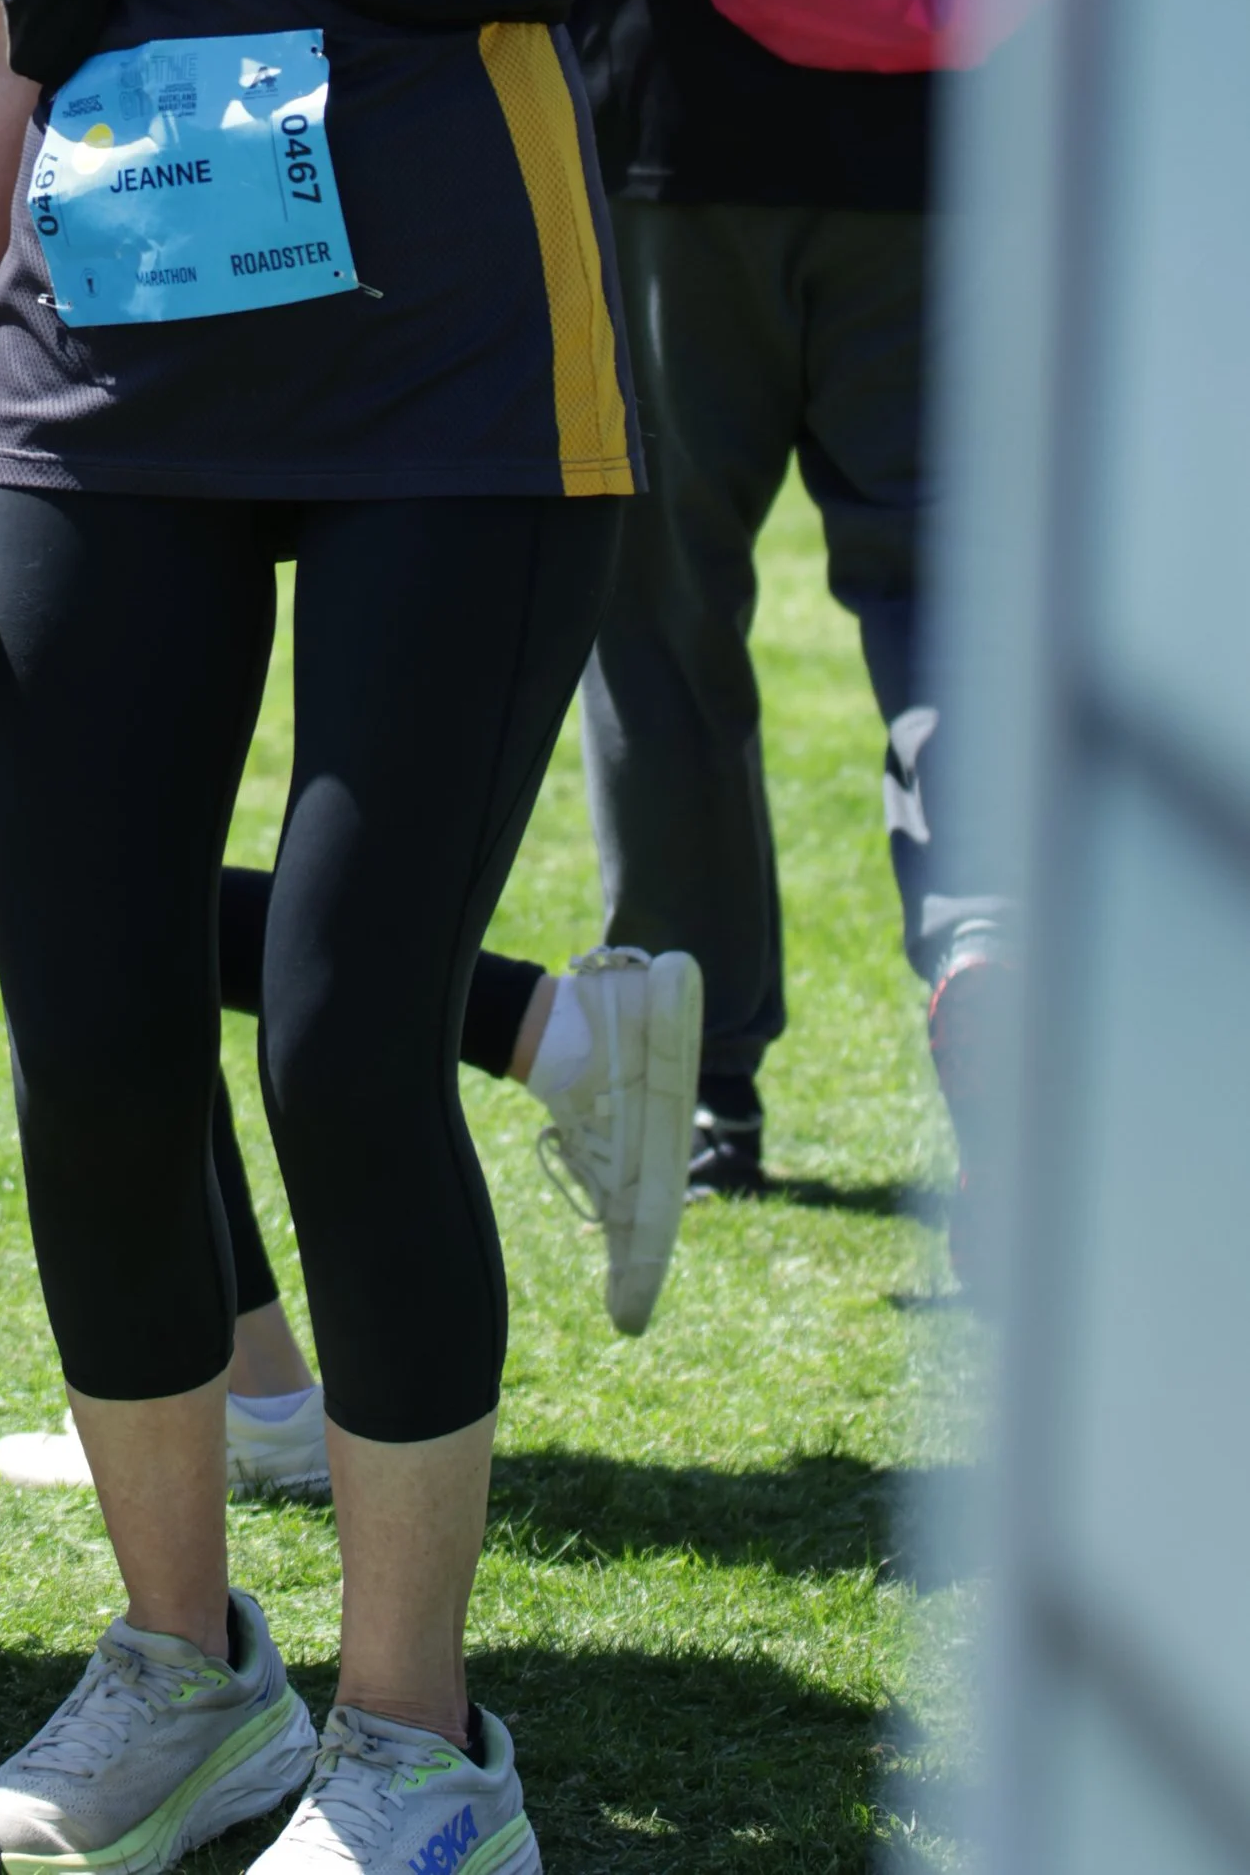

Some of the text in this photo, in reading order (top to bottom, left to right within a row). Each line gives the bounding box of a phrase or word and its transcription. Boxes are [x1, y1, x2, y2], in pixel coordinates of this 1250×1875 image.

[110, 159, 213, 194] JEANNE
[280, 113, 323, 205] 0467
[31, 152, 60, 237] 0467
[135, 266, 198, 288] MARATHON
[230, 241, 332, 277] ROADSTER
[407, 1804, 478, 1875] HOKA
